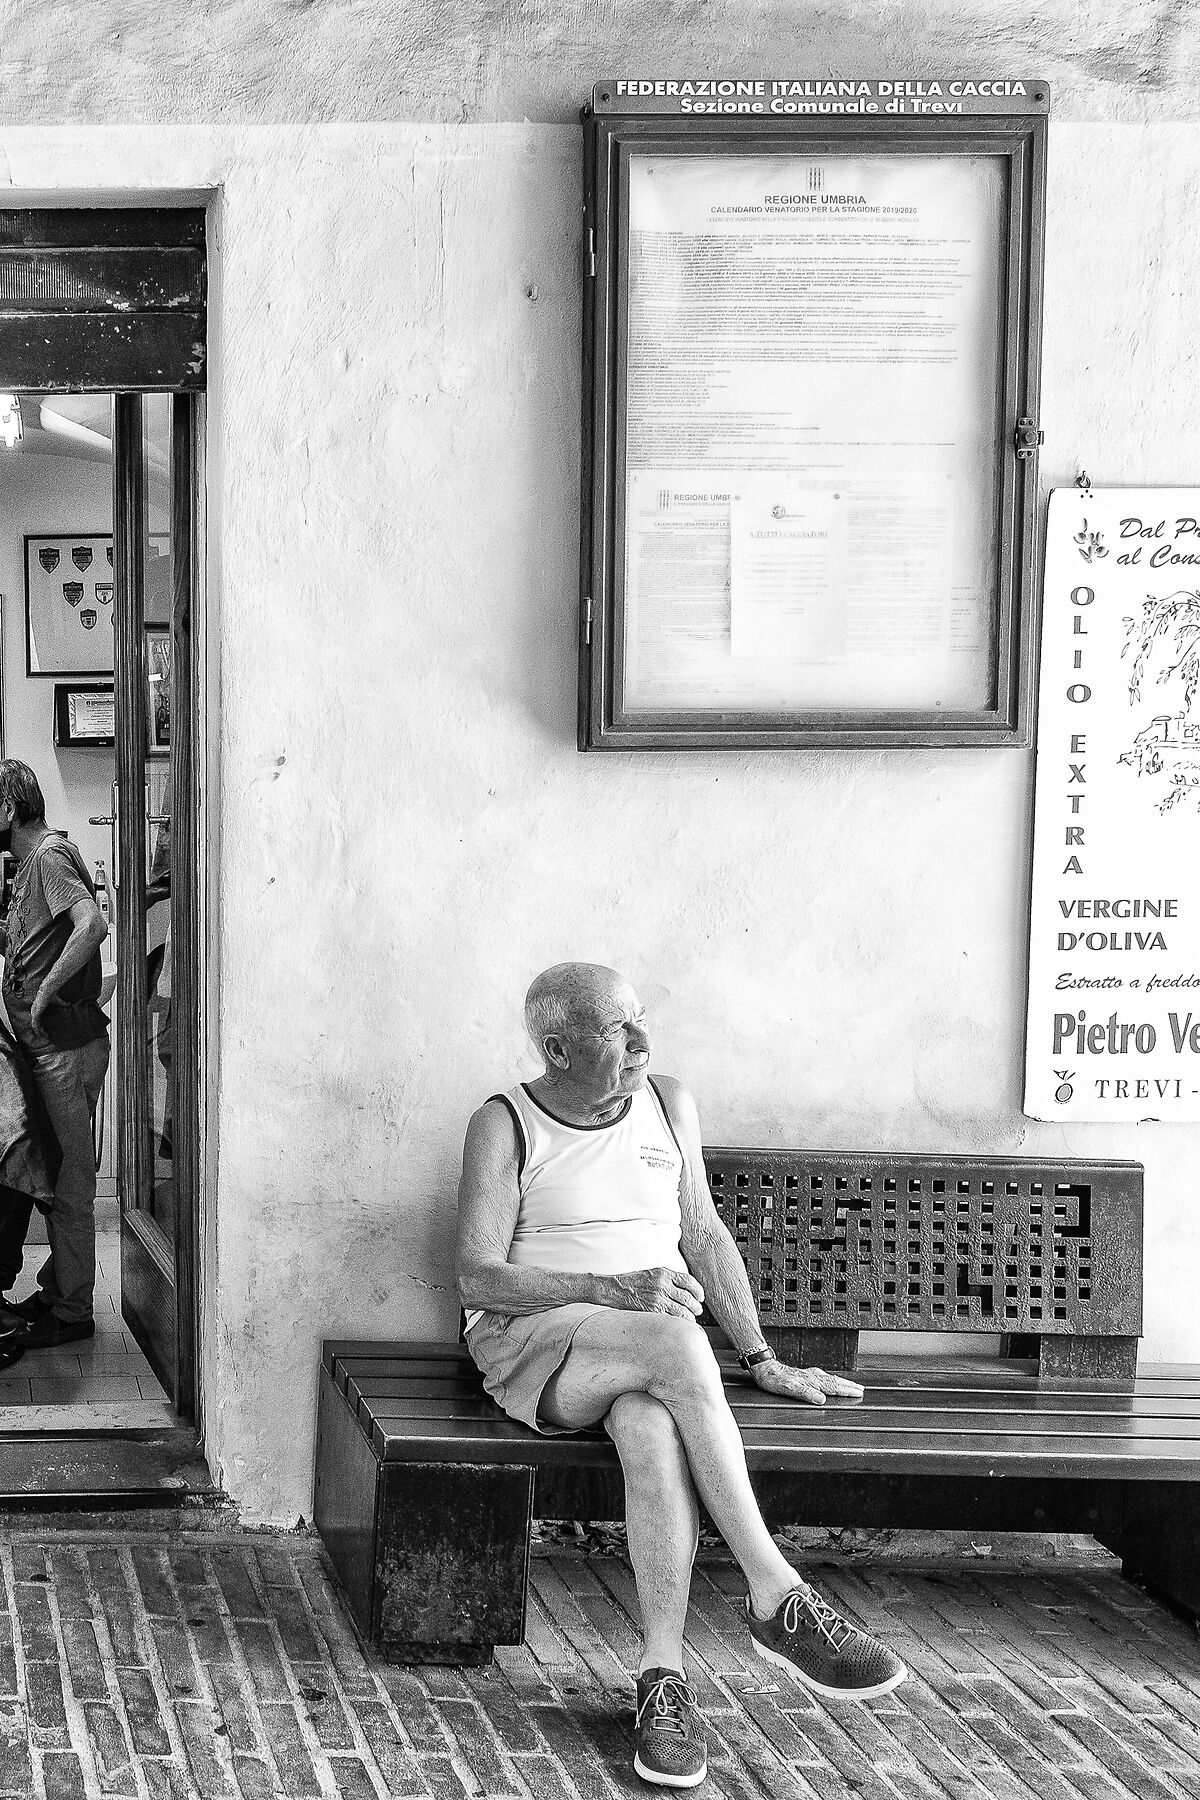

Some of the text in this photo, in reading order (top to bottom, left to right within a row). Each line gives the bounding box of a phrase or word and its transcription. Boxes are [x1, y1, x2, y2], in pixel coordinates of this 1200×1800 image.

[615, 80, 1027, 97] FEDERAZIONE ITALIANA DELLA CACCIA
[679, 98, 963, 114] Sezione Comunale di Trevi
[764, 194, 867, 205] REGIONE UMBRIA
[711, 206, 763, 214] CALENDARIO
[882, 206, 918, 214] 2019/2020
[1119, 517, 1165, 539] Dal
[1116, 546, 1142, 566] al
[1067, 586, 1095, 704] OLIO
[1062, 735, 1087, 875] EXTRA
[1058, 899, 1178, 919] VERGINE
[1057, 931, 1168, 951] D'OLIVA
[1054, 972, 1200, 993] Estratto a freddo
[1052, 1009, 1157, 1055] Pietro
[1094, 1079, 1183, 1099] TREVI
